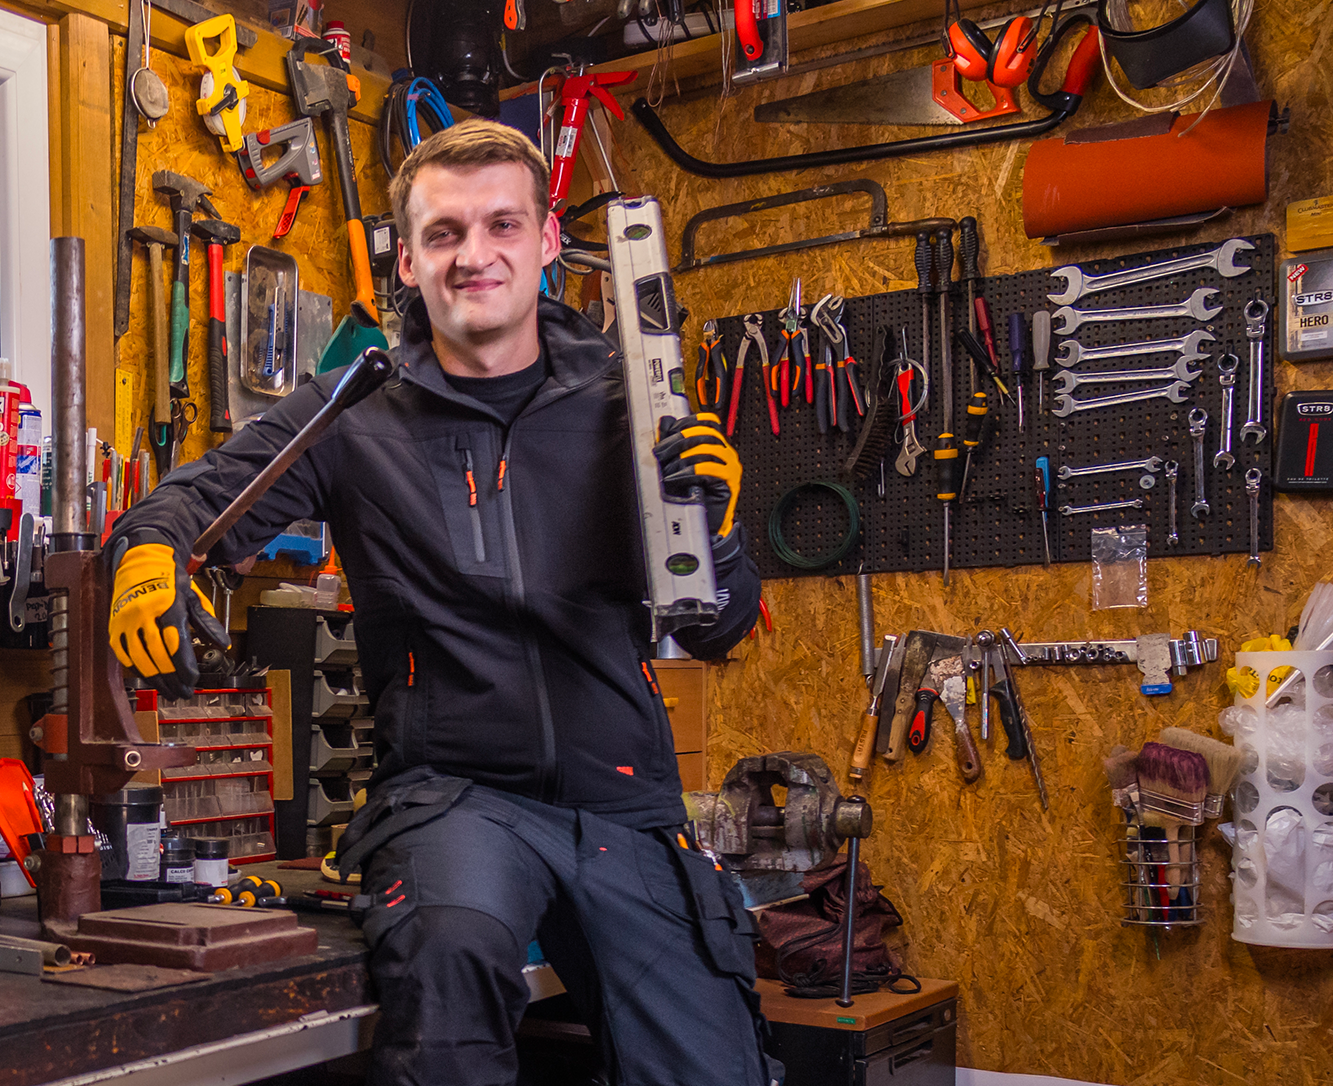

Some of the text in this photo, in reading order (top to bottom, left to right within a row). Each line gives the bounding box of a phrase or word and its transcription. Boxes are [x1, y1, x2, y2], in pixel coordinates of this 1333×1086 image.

[1289, 265, 1306, 282] NEW
[1296, 291, 1333, 304] STR8
[1299, 314, 1329, 328] HERO
[1302, 405, 1331, 413] STR8
[112, 582, 170, 617] BENNON
